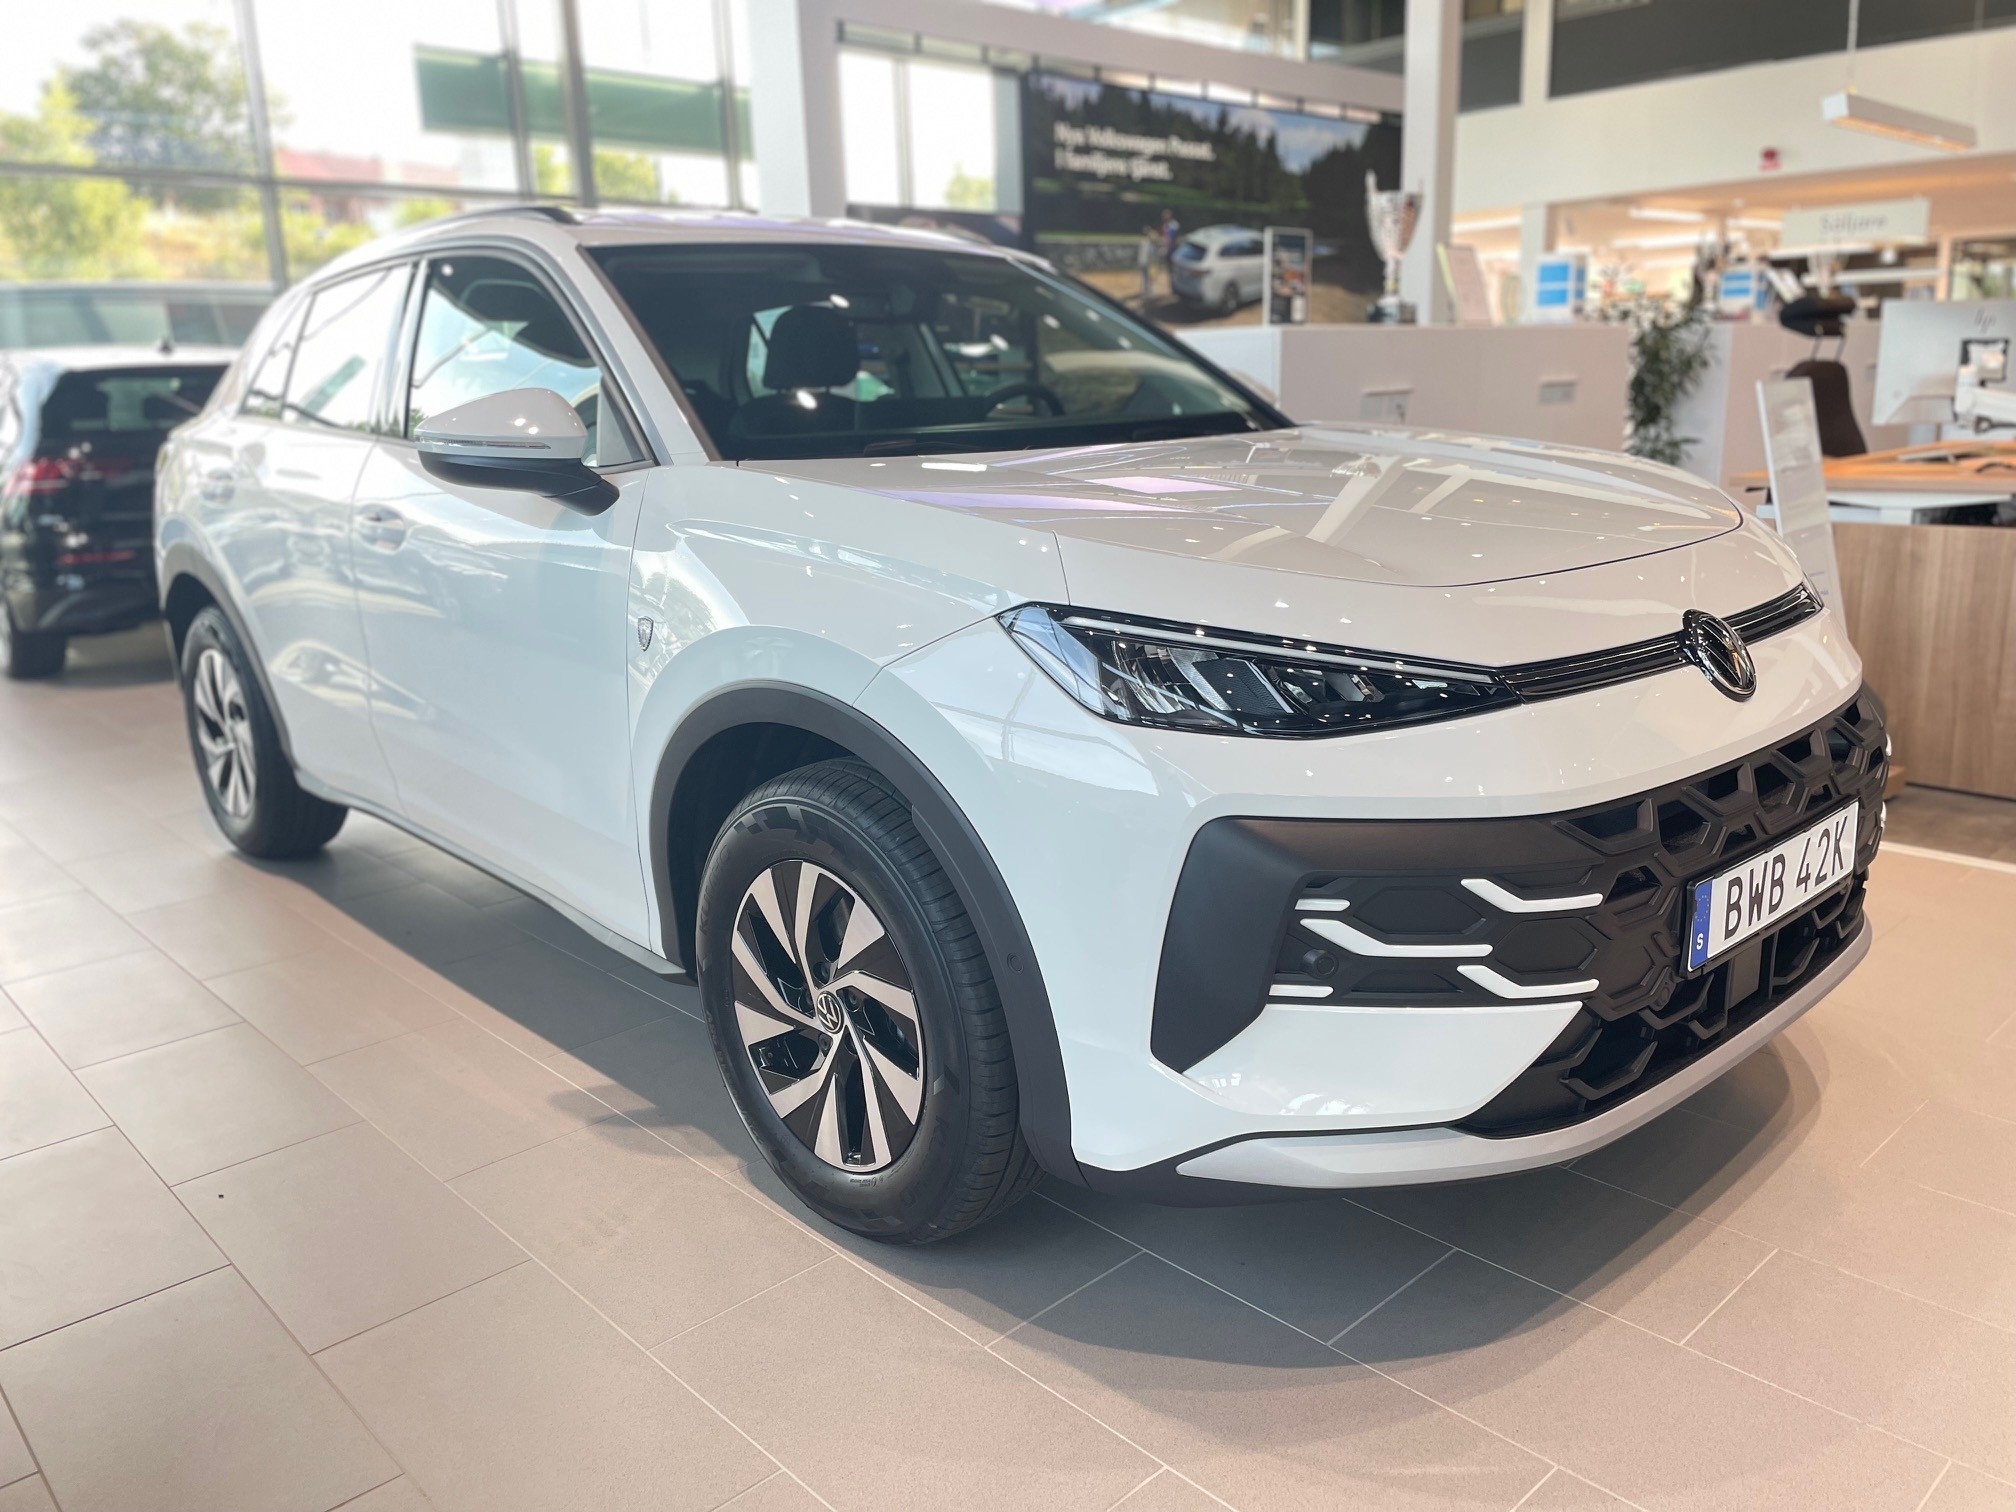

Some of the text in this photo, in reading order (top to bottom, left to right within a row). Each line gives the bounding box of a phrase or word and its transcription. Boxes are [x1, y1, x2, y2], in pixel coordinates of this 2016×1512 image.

[1724, 815, 1848, 942] BWB 42K
[1696, 932, 1704, 951] S
